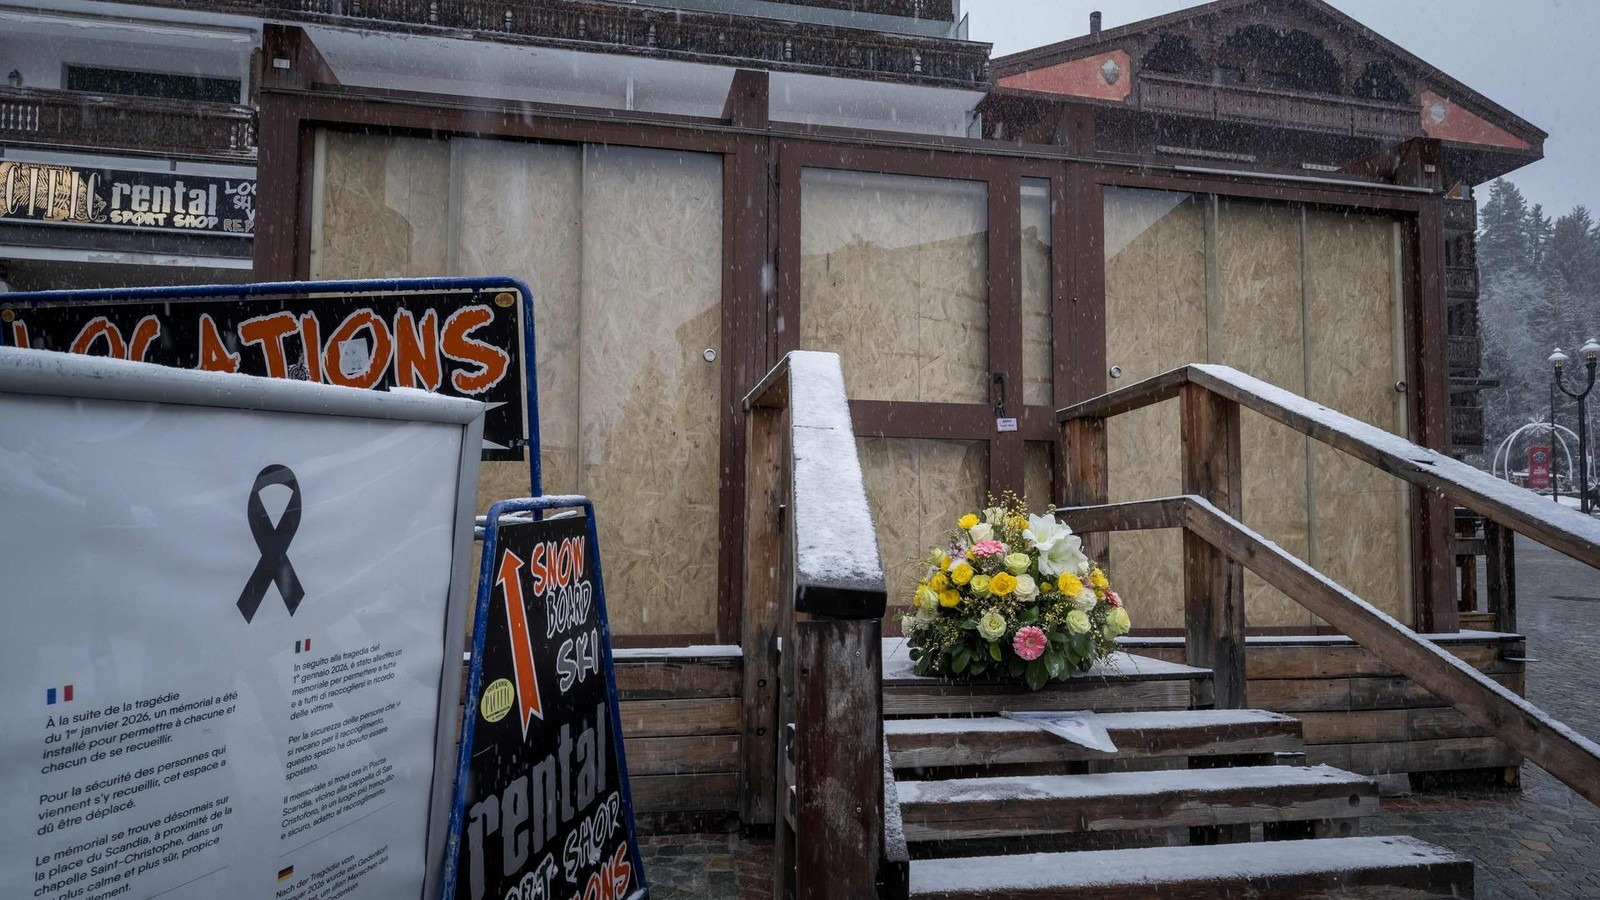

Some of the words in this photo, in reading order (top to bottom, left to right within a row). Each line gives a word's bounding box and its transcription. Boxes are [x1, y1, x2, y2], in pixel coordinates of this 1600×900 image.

[109, 209, 168, 227] SPORT
[173, 214, 219, 230] SHOP
[111, 180, 218, 216] rental
[531, 535, 586, 598] SNOW
[545, 580, 593, 639] BOARD
[294, 664, 301, 672] In
[302, 657, 329, 670] seguito
[330, 654, 342, 664] alla
[342, 646, 369, 660] tragedia
[370, 644, 381, 652] del
[300, 669, 330, 684] gennaio
[330, 664, 350, 674] 2026,
[356, 656, 372, 667] stato
[556, 627, 599, 693] SKI
[292, 680, 330, 696] memoriale
[330, 676, 342, 688] per
[343, 666, 378, 682] permettere
[304, 694, 318, 705] tutti
[320, 692, 327, 700] di
[328, 680, 366, 698] raccogliersi
[366, 678, 373, 686] in
[373, 672, 396, 684] ricordo
[44, 733, 62, 744] du
[80, 720, 120, 738] janvier
[121, 712, 152, 728] 2026,
[154, 709, 167, 720] un
[169, 697, 214, 716] mémorial
[223, 692, 238, 702] été
[46, 716, 56, 729] À
[59, 715, 70, 726] la
[72, 710, 101, 724] suite
[104, 706, 120, 716] de
[122, 702, 132, 712] la
[135, 692, 180, 708] tragédie
[288, 734, 301, 745] Per
[302, 732, 308, 740] la
[310, 722, 342, 738] sicurezza
[342, 715, 360, 726] delle
[360, 707, 385, 722] persone
[384, 702, 396, 712] che
[290, 708, 310, 720] delle
[310, 702, 336, 714] vittime.
[42, 742, 86, 760] installé
[88, 734, 117, 751] pour
[119, 721, 174, 742] permettre
[175, 718, 182, 728] à
[184, 708, 225, 726] chacune
[226, 705, 236, 715] et
[294, 741, 320, 754] recano
[321, 734, 334, 746] per
[334, 732, 339, 740] il
[39, 790, 69, 806] Pour
[72, 785, 82, 796] la
[84, 772, 132, 792] sécurité
[134, 767, 154, 780] des
[156, 751, 210, 774] personnes
[211, 744, 227, 758] qui
[40, 755, 88, 775] chacun
[90, 749, 107, 762] de
[109, 746, 123, 758] se
[125, 734, 174, 754] recueillir.
[285, 764, 318, 780] spostato.
[286, 752, 312, 770] questo
[313, 746, 336, 759] spazio
[337, 742, 346, 750] ha
[38, 798, 92, 820] viennent
[94, 793, 110, 807] s'y
[112, 778, 161, 800] recueillir,
[164, 772, 180, 784] cet
[182, 762, 220, 780] espace
[467, 702, 607, 900] rental
[35, 855, 50, 867] Le
[54, 836, 108, 862] mémorial
[111, 831, 125, 841] se
[127, 819, 161, 837] trouve
[164, 802, 214, 824] désormais
[216, 796, 230, 808] sur
[37, 823, 54, 836] dû
[57, 816, 82, 831] être
[85, 800, 136, 822] déplacé.
[563, 790, 621, 883] SHOP
[34, 871, 45, 882] la
[48, 858, 84, 880] place
[86, 852, 102, 864] du
[105, 836, 152, 858] Scandia,
[154, 831, 160, 841] à
[162, 814, 208, 840] proximité
[210, 810, 222, 821] de
[224, 806, 233, 816] la
[34, 871, 88, 898] chapelle
[90, 838, 184, 878] Saint-Christophe,
[186, 829, 210, 842] dans
[212, 822, 224, 834] un
[86, 873, 122, 893] calme
[124, 868, 136, 880] et
[138, 858, 160, 876] plus
[162, 852, 180, 865] sûr,
[181, 837, 220, 859] propice
